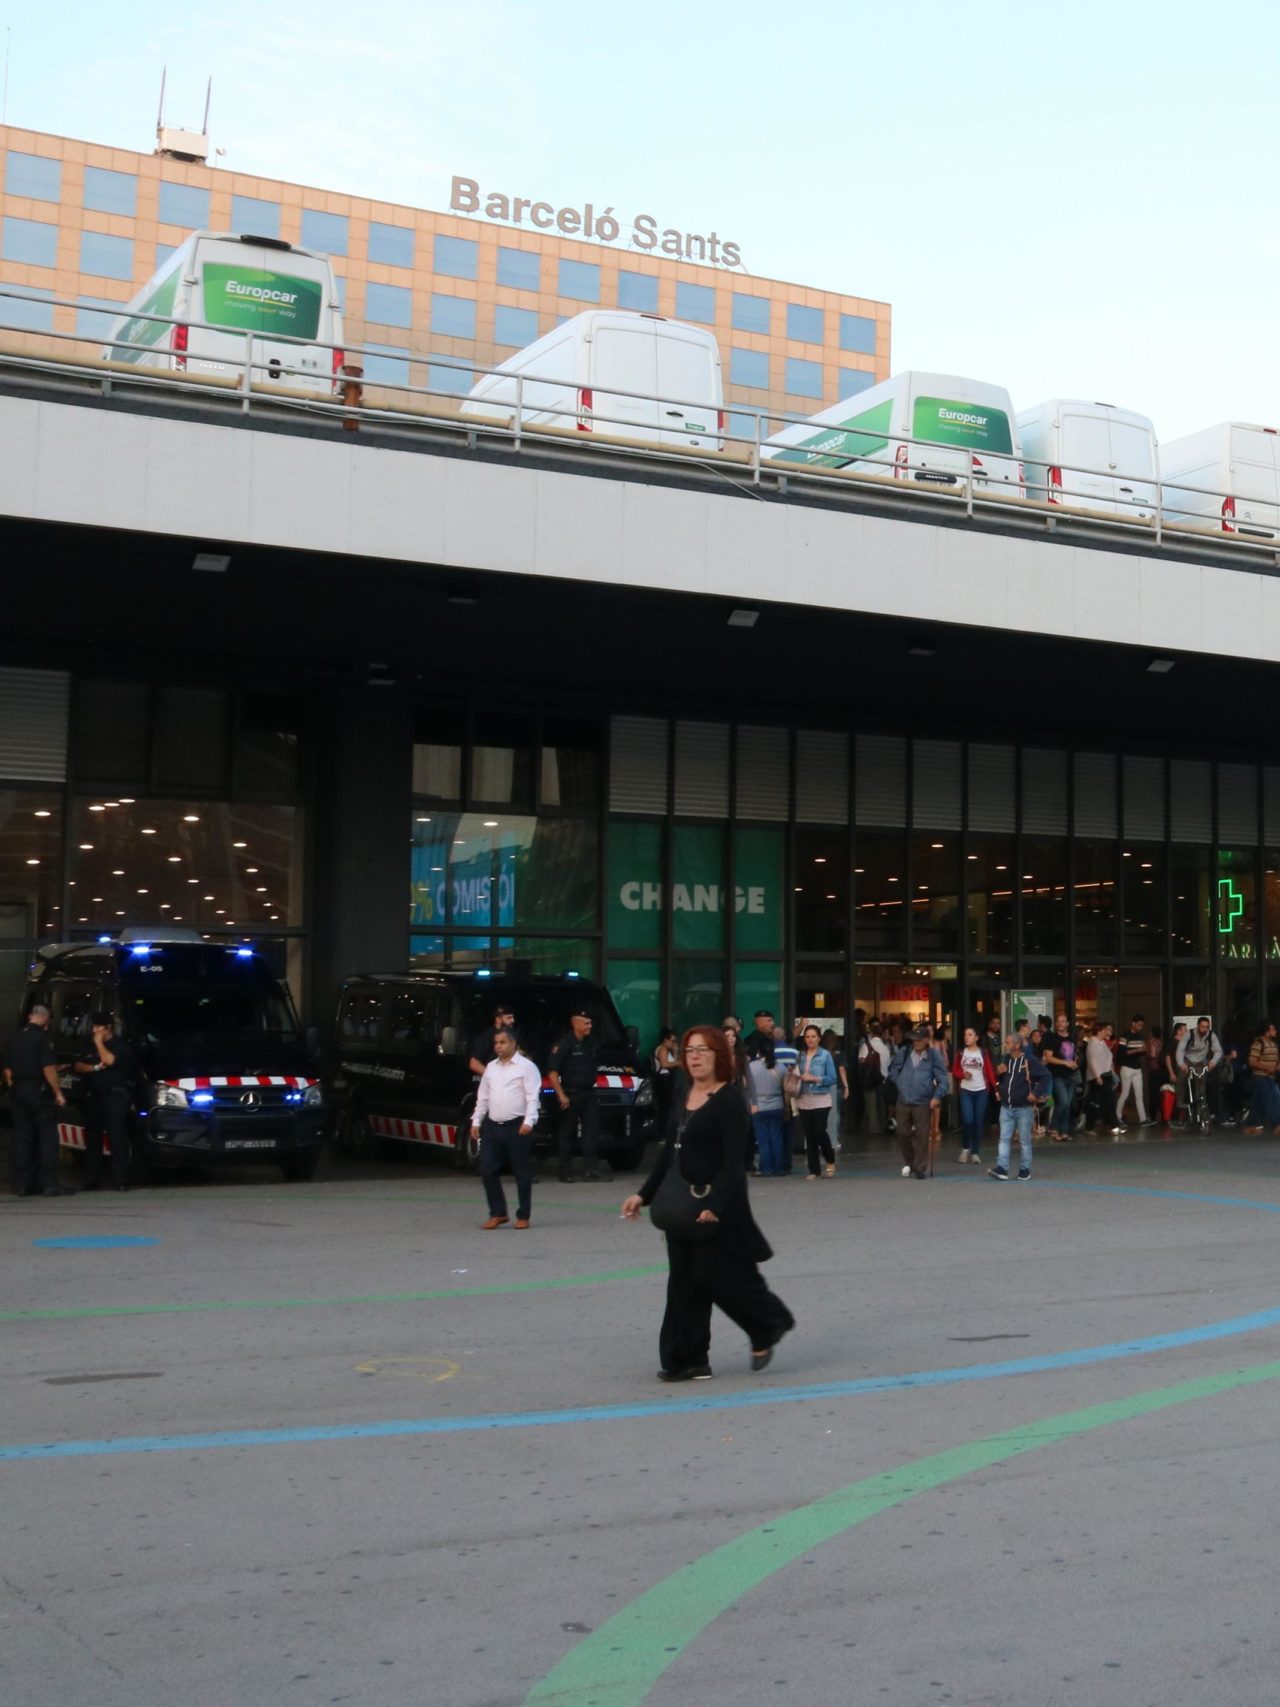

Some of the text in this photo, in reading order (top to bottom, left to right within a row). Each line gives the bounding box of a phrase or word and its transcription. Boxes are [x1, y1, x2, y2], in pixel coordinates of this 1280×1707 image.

[450, 175, 742, 267] Barceló Sants
[225, 280, 298, 304] Europcar
[223, 300, 257, 313] moving
[279, 308, 297, 319] way
[938, 408, 988, 425] Europcar
[620, 881, 765, 914] CHANGE
